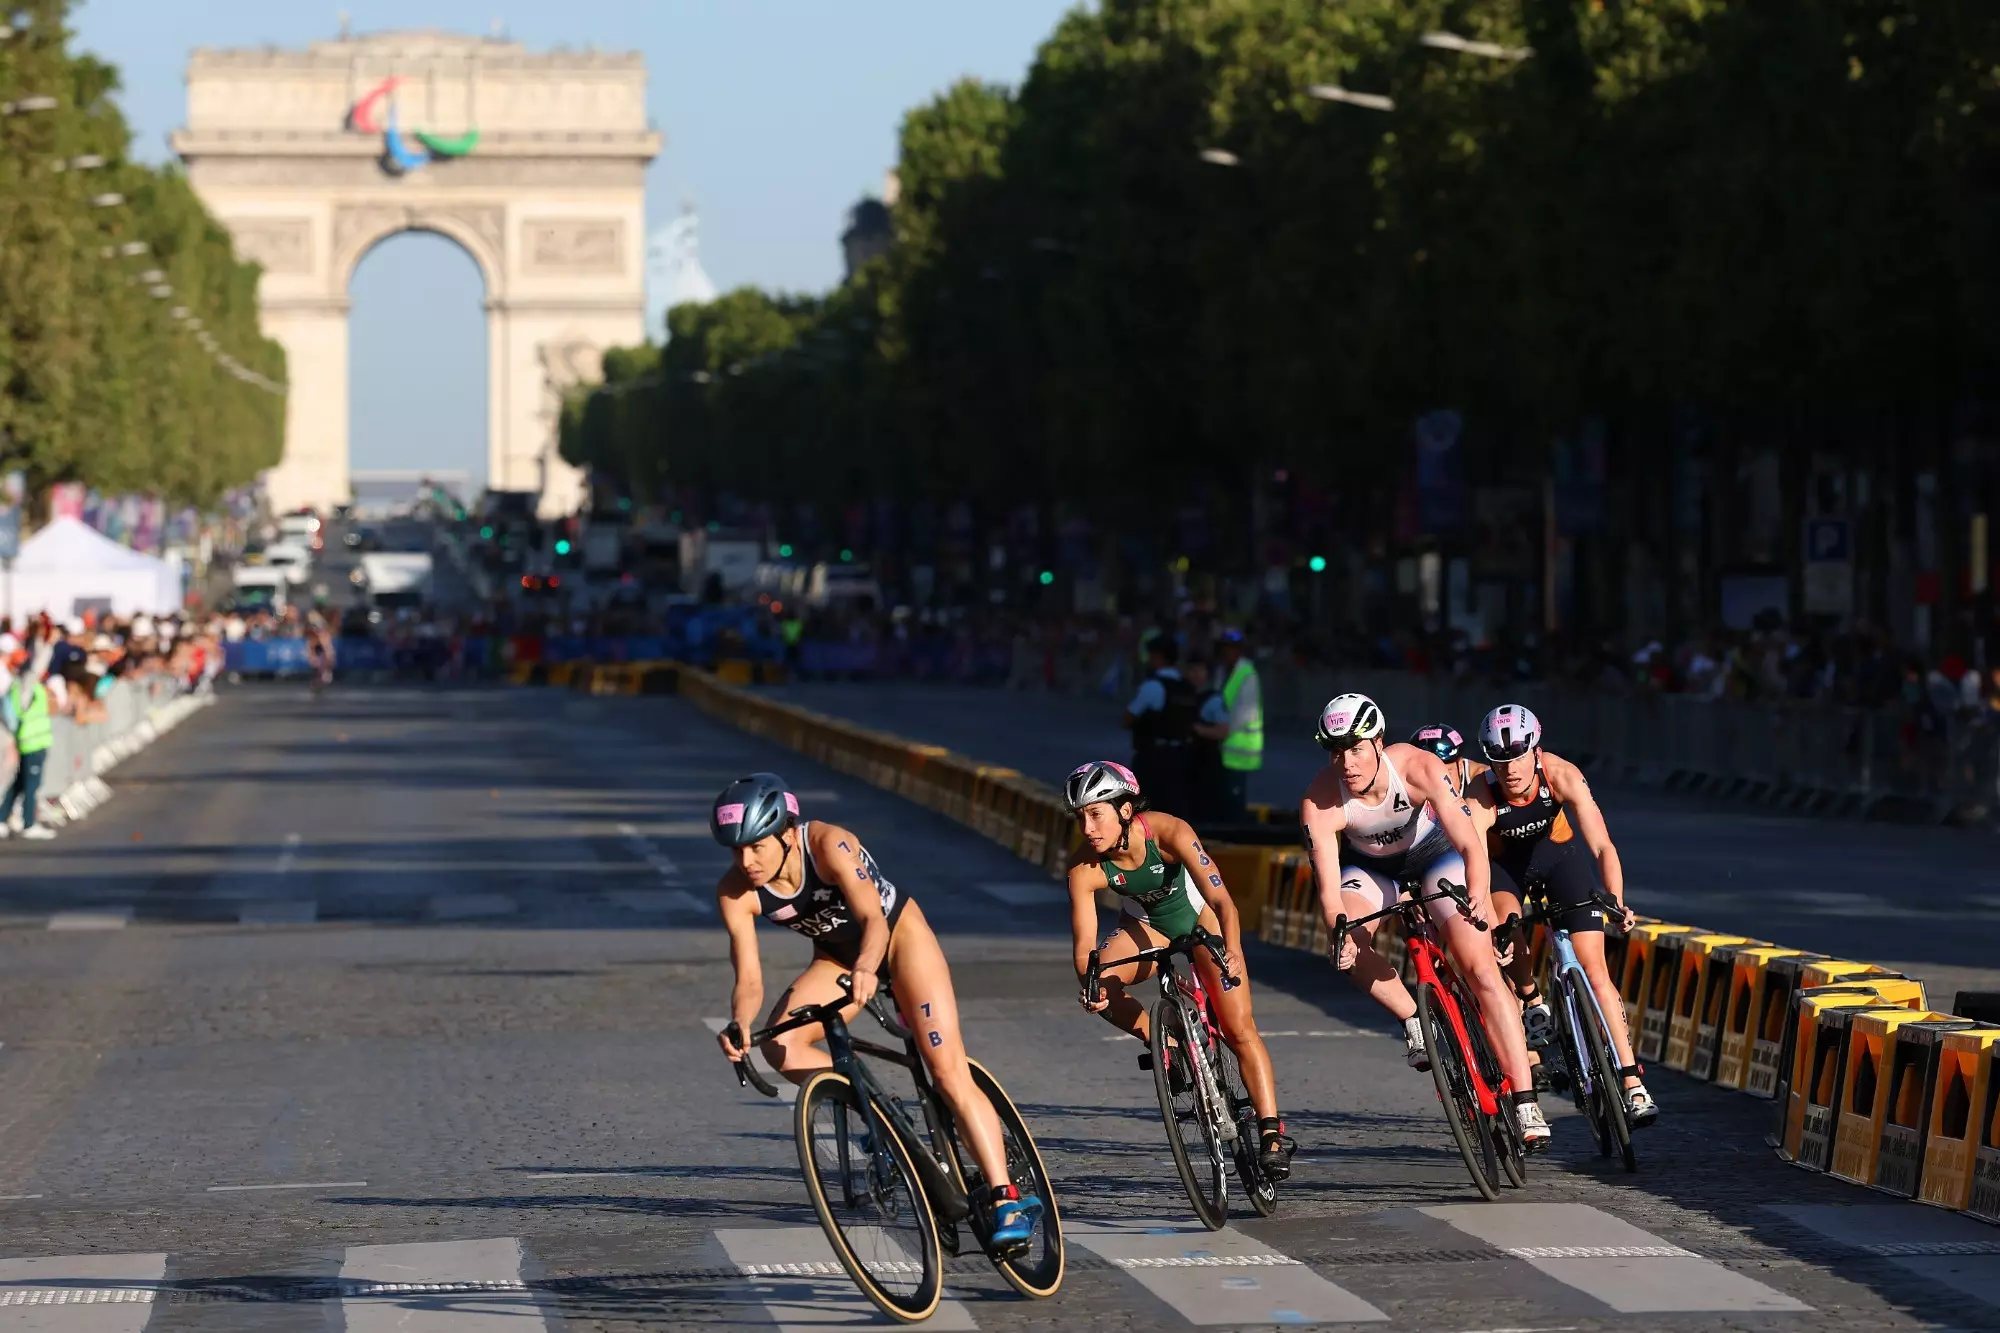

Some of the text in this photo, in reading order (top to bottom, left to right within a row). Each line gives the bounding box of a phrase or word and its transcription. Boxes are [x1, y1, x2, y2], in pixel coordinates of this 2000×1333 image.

[1460, 804, 1472, 817] B
[1375, 830, 1403, 846] NOR
[837, 841, 851, 853] 7
[855, 867, 868, 880] B
[1208, 873, 1222, 888] B
[1139, 883, 1179, 903] MEX
[803, 916, 848, 936] USA
[920, 1002, 931, 1018] 7
[928, 1030, 943, 1048] B
